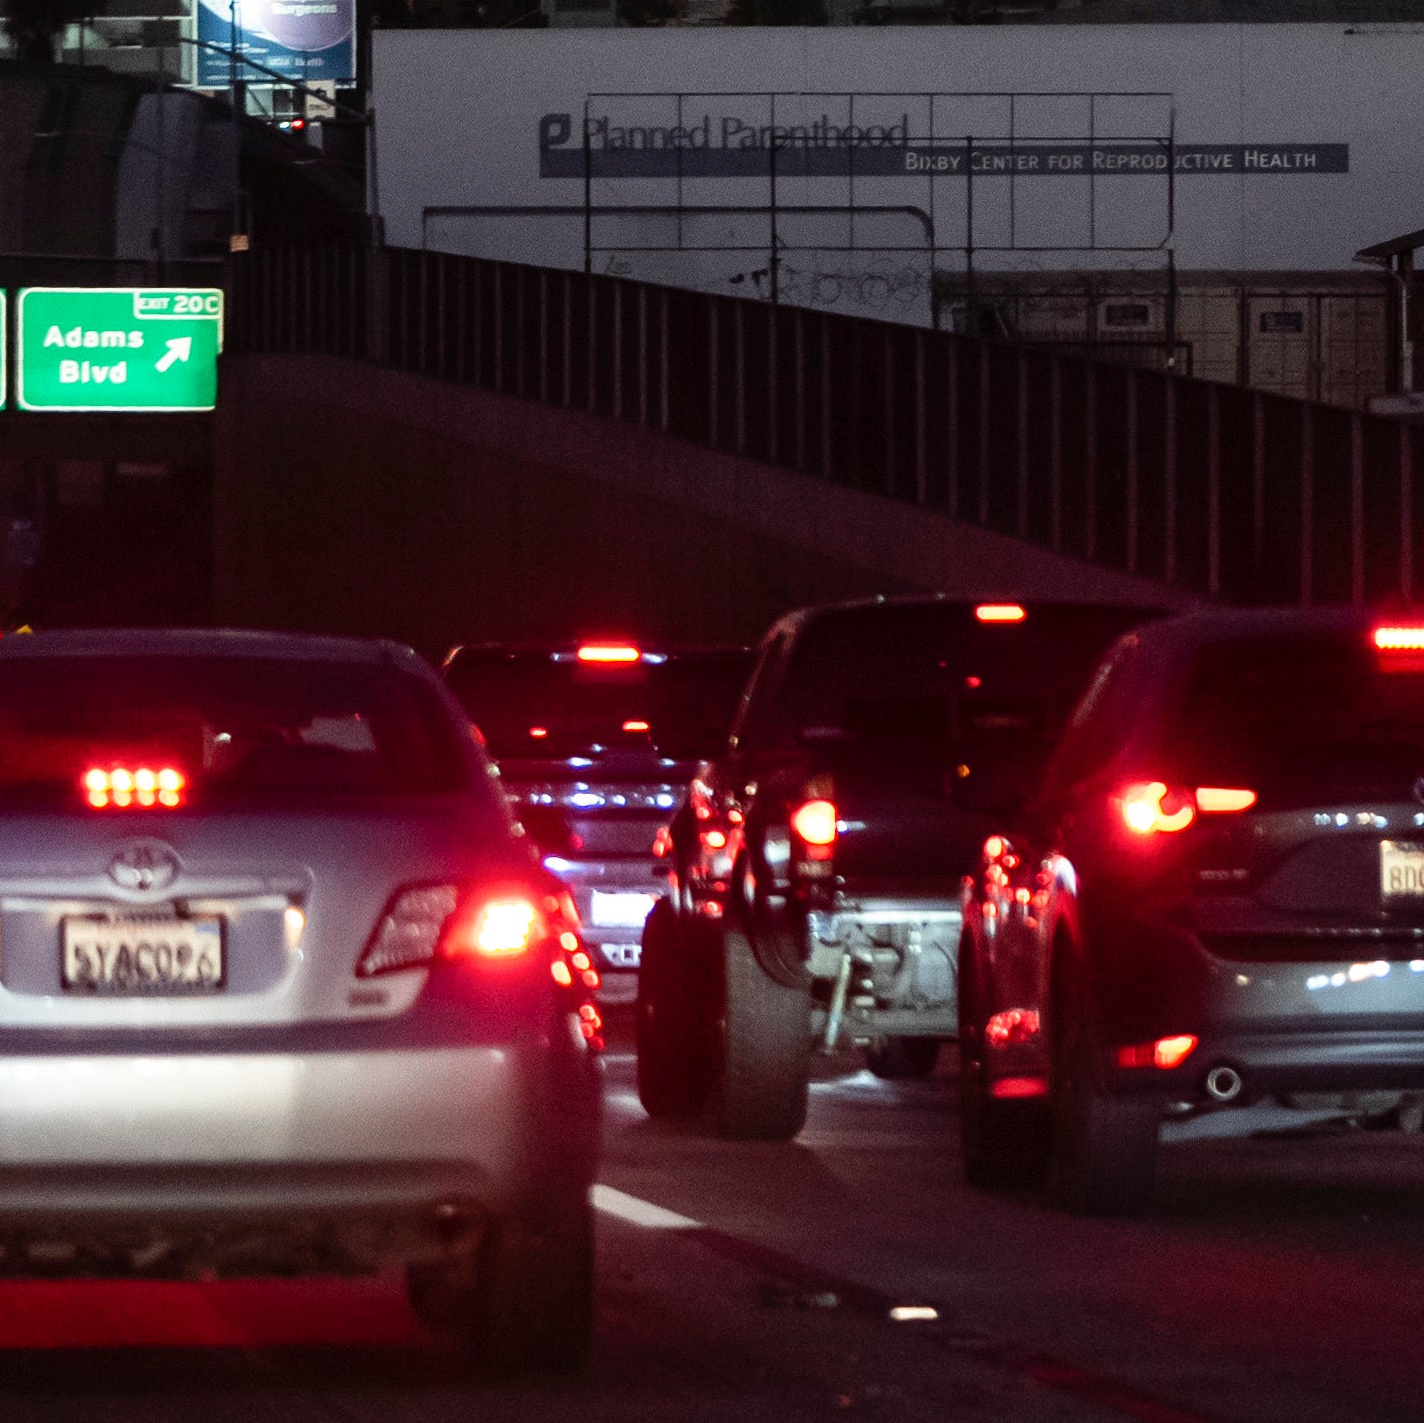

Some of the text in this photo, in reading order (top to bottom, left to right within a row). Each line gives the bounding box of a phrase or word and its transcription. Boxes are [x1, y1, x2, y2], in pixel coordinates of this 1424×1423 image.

[271, 2, 338, 16] Surgeons
[582, 114, 909, 151] Planned Parenthood
[139, 295, 219, 314] EXIT 20C
[42, 325, 145, 349] Adams
[59, 359, 127, 384] Blvd
